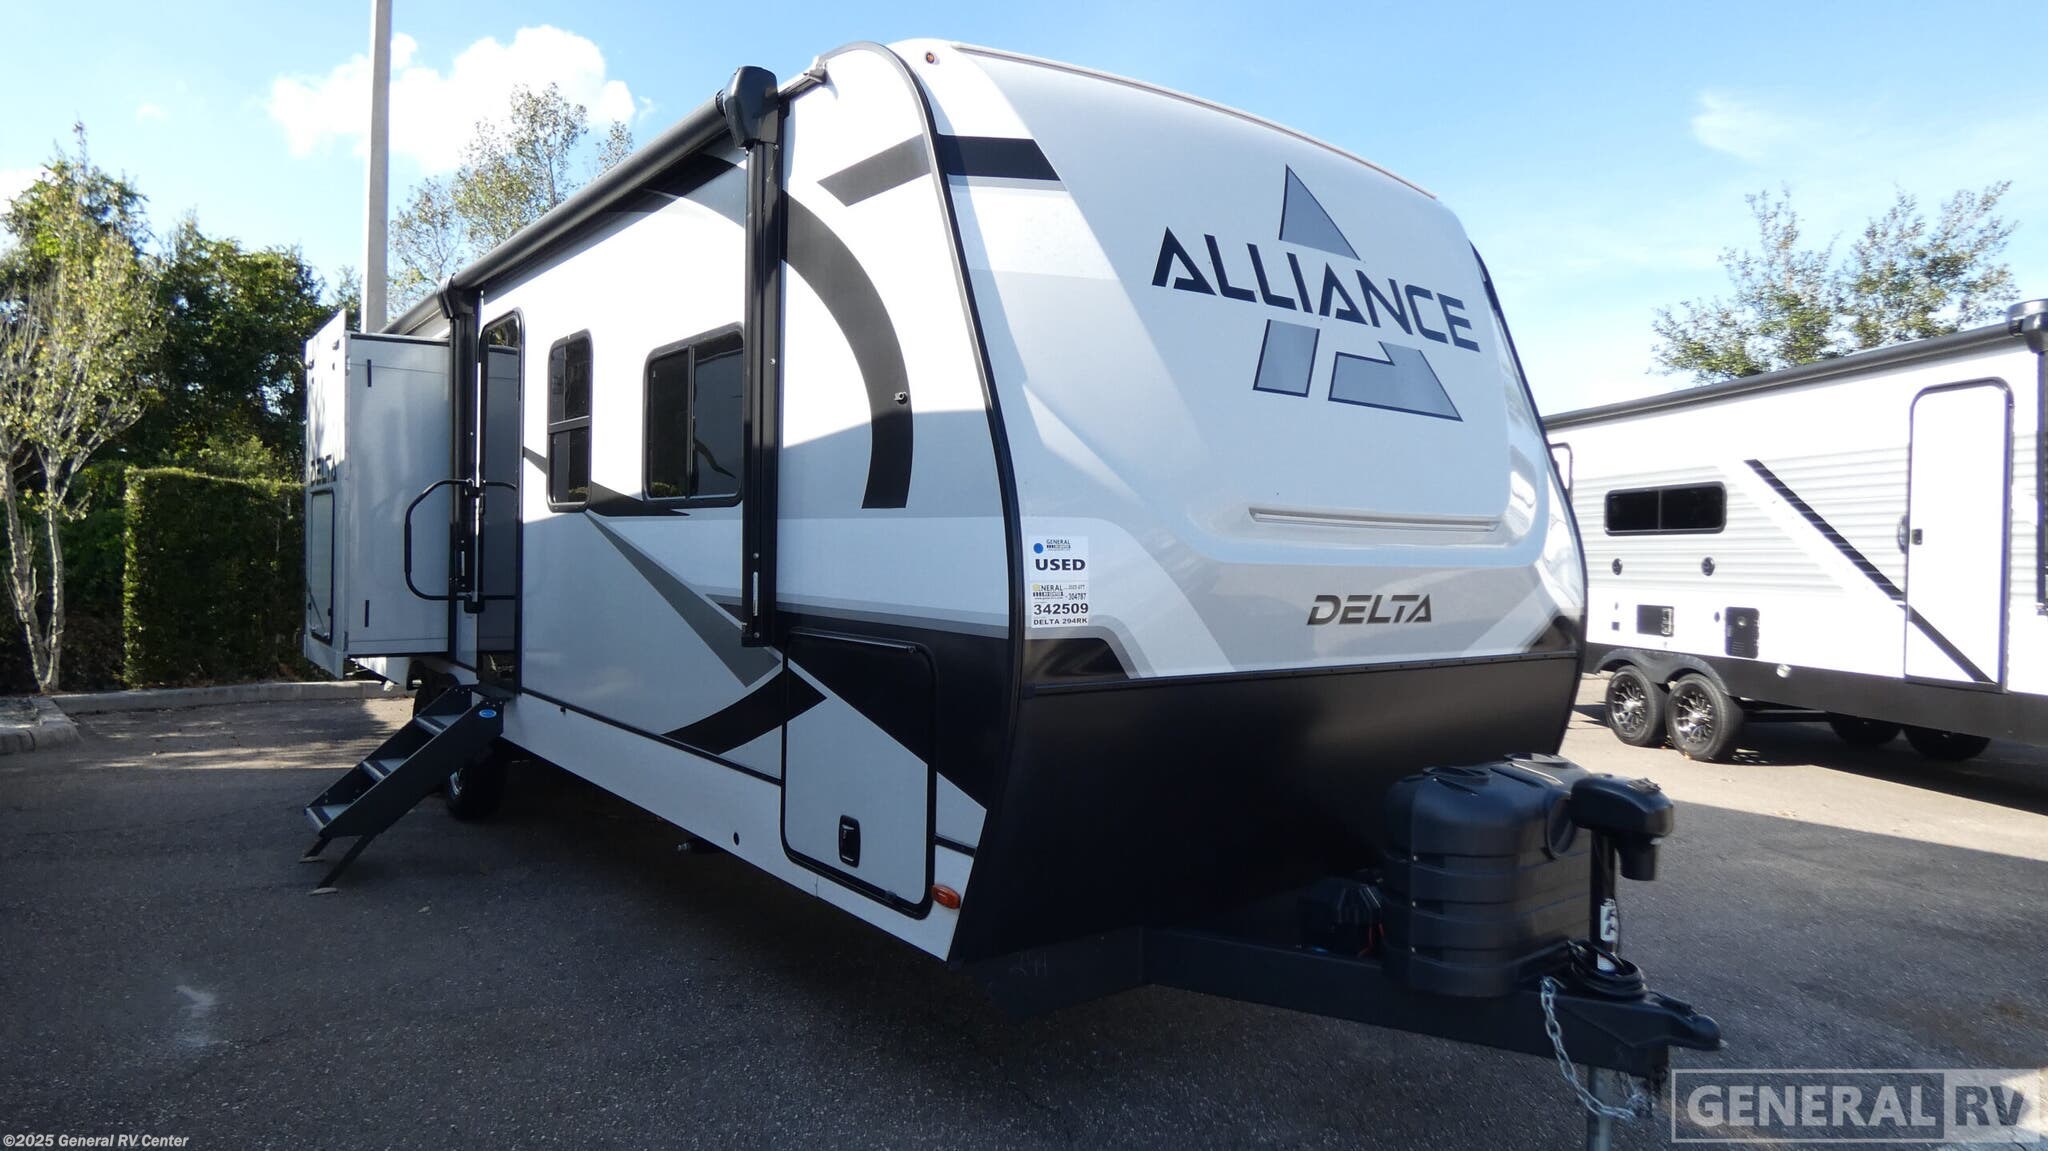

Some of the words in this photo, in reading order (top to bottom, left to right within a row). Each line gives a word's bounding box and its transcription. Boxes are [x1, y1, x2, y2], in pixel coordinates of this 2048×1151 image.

[1152, 226, 1480, 353] ALLIANCE
[1035, 558, 1086, 571] USED
[1033, 602, 1089, 615] 342509
[1307, 594, 1433, 626] DELTA
[1062, 617, 1088, 625] 294RK
